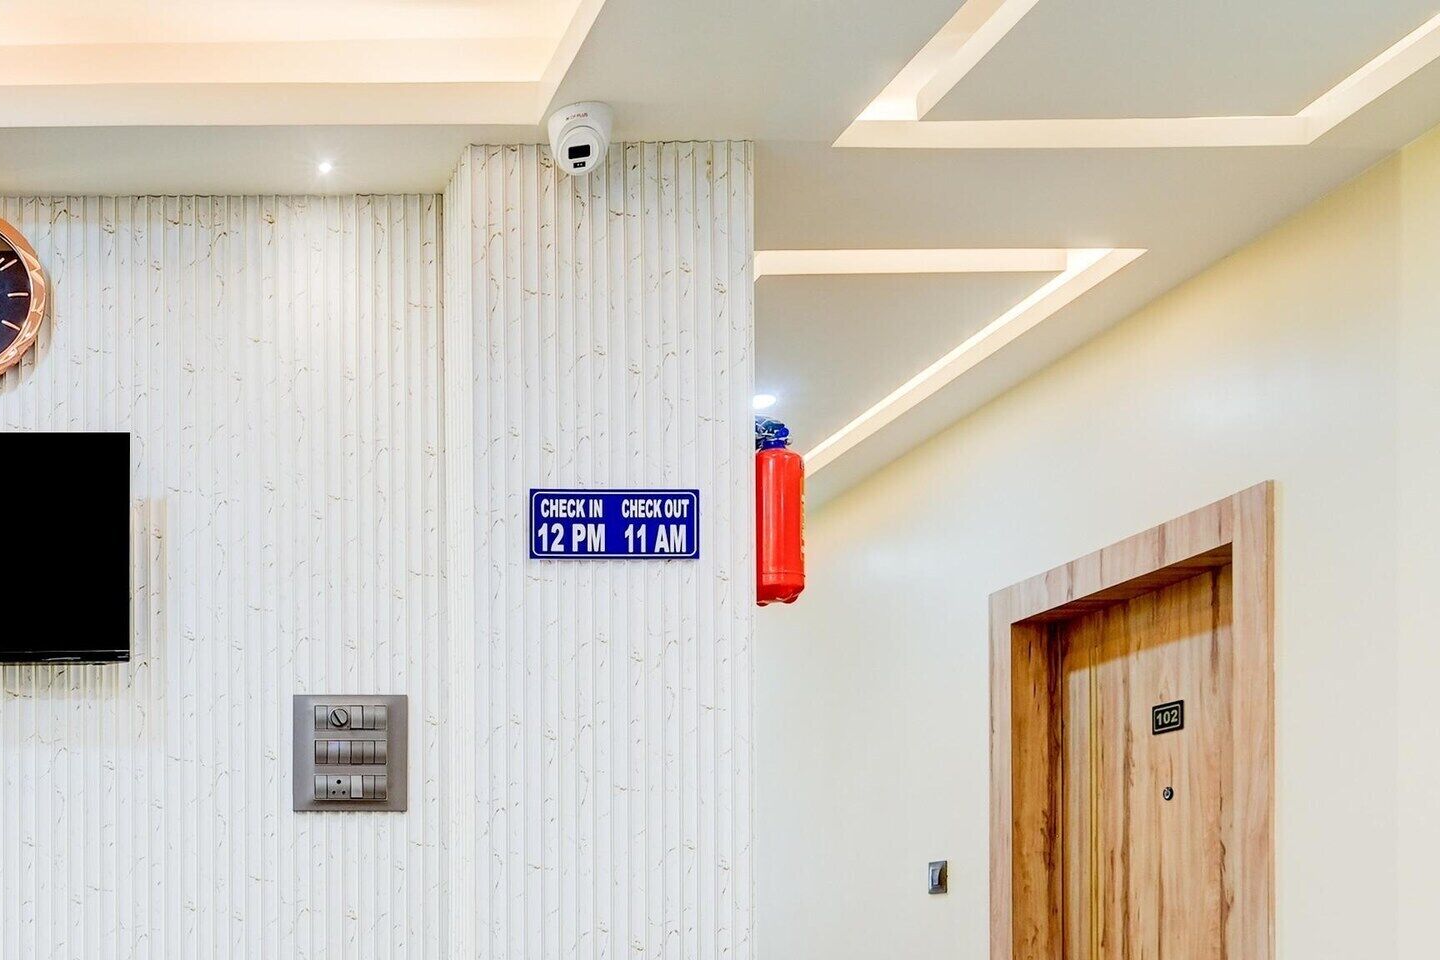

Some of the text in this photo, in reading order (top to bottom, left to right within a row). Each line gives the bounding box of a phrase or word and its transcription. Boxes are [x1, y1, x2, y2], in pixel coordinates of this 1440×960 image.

[540, 499, 603, 518] CHECK IN
[621, 499, 690, 518] CHECK OUT
[537, 523, 606, 552] 12 PM
[624, 523, 687, 553] 11 AM
[1156, 709, 1178, 726] 102
